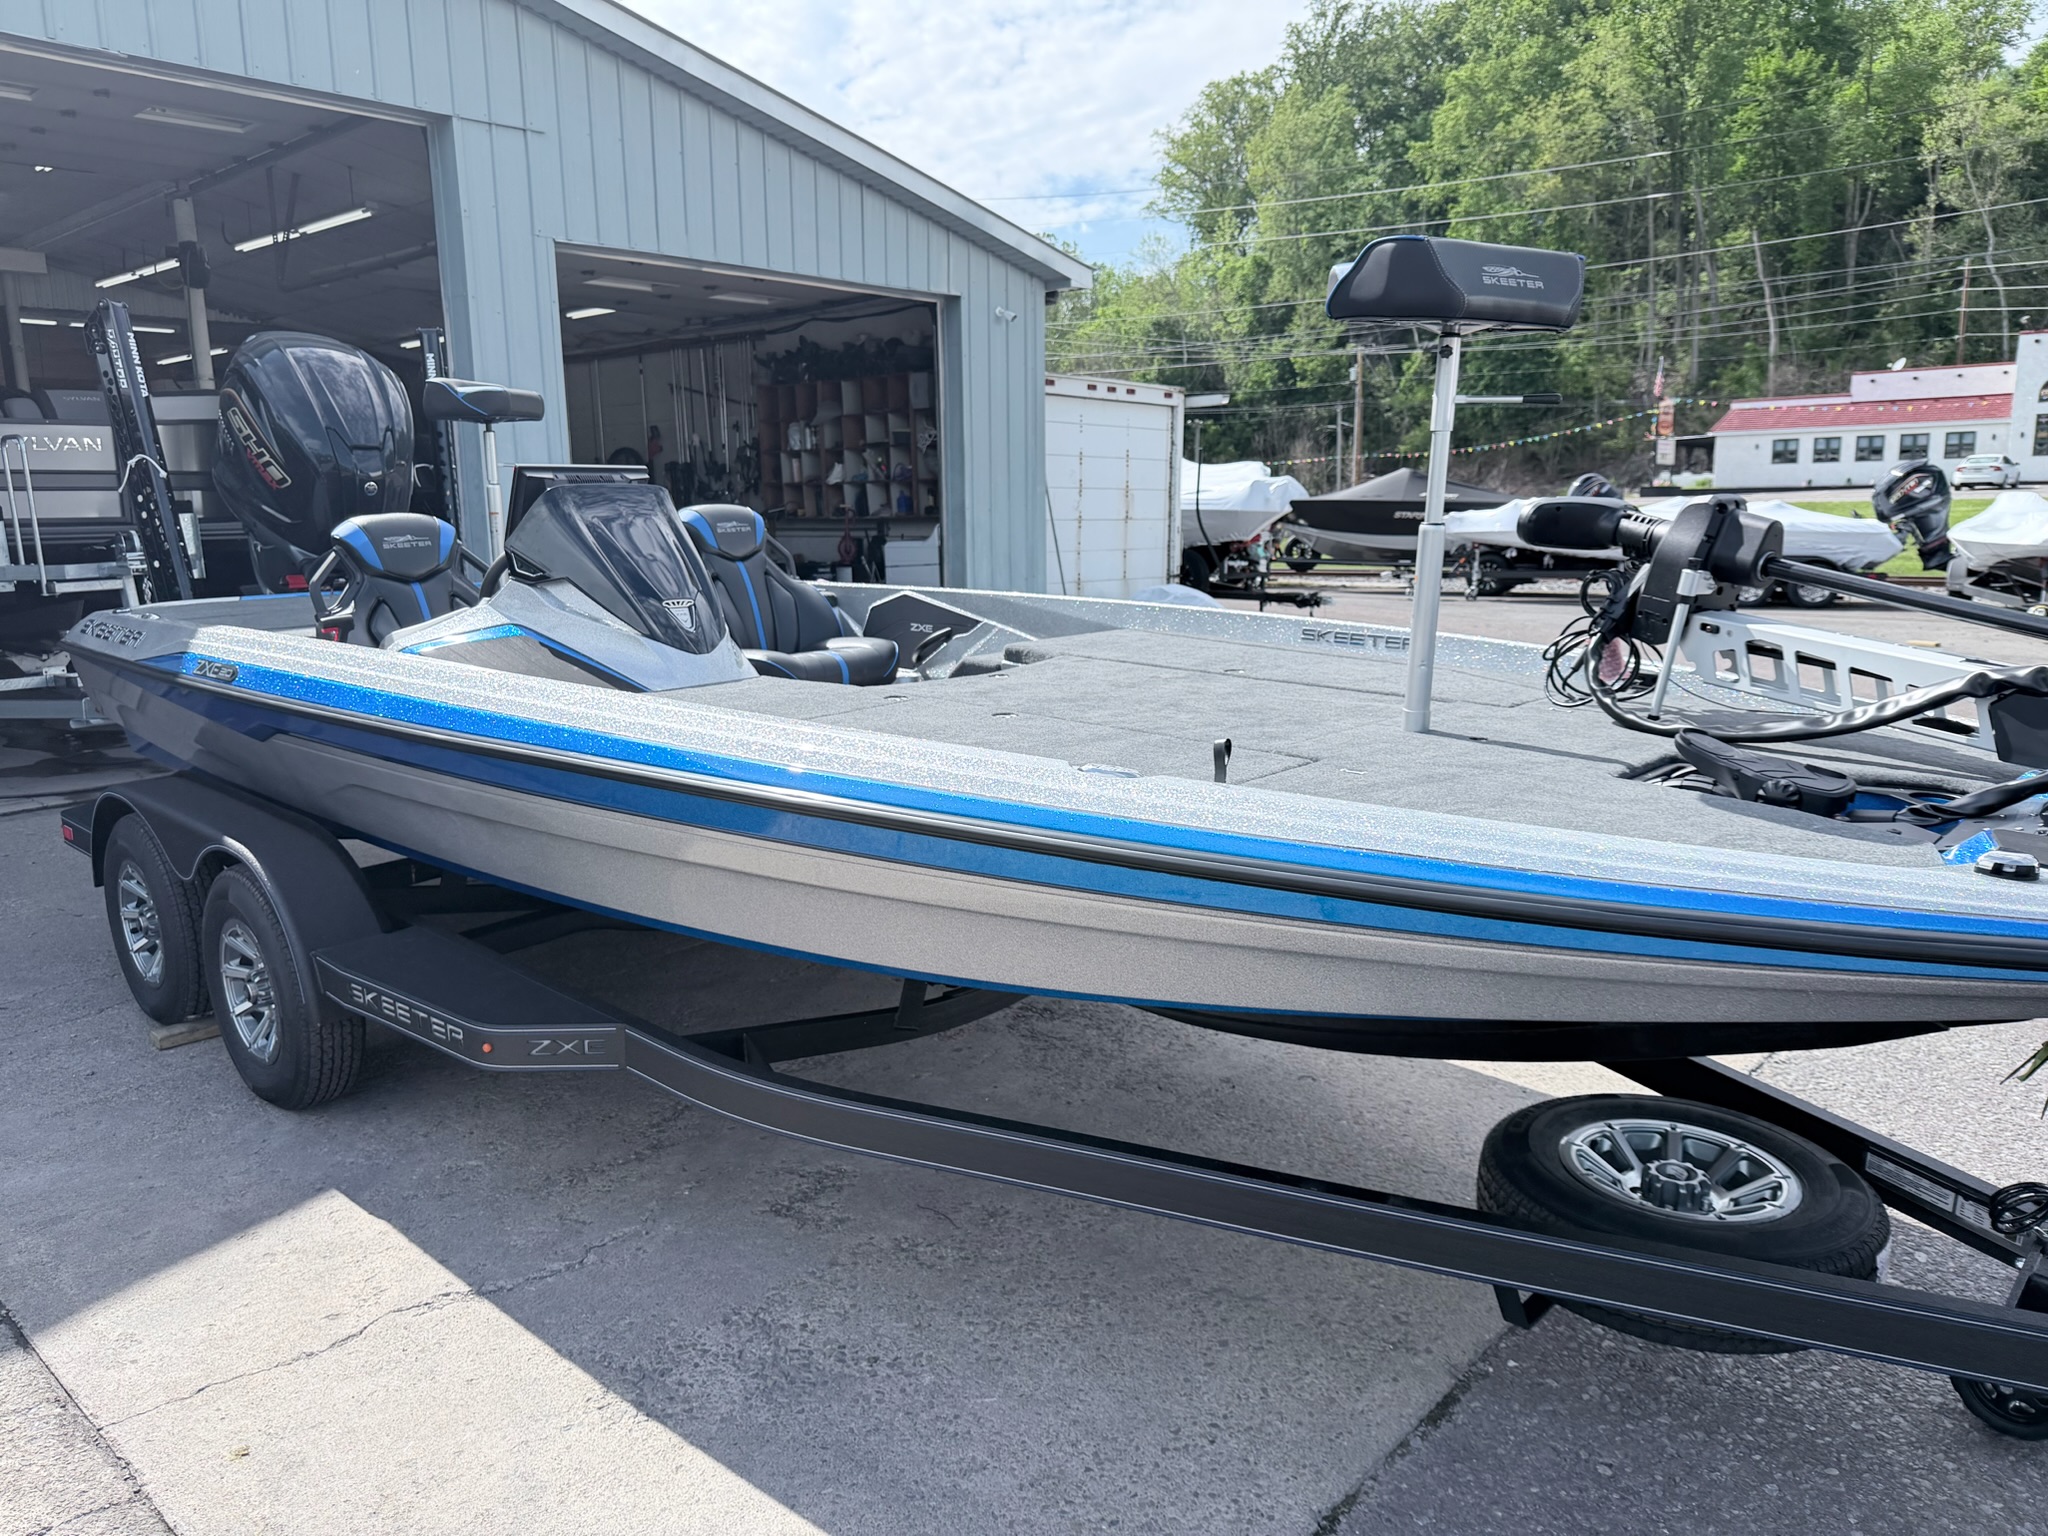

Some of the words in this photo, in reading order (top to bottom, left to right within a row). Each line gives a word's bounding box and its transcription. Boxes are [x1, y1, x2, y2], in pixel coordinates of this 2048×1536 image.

[1482, 276, 1544, 289] SKEETER
[127, 331, 141, 365] MINN
[134, 364, 149, 397] KOTA
[226, 407, 292, 488] SHO
[382, 540, 432, 549] SKEETER
[910, 623, 933, 632] ZXE
[193, 659, 221, 678] ZXE
[219, 667, 233, 678] 20
[350, 983, 464, 1046] SKEETER
[528, 1039, 606, 1055] ZXE
